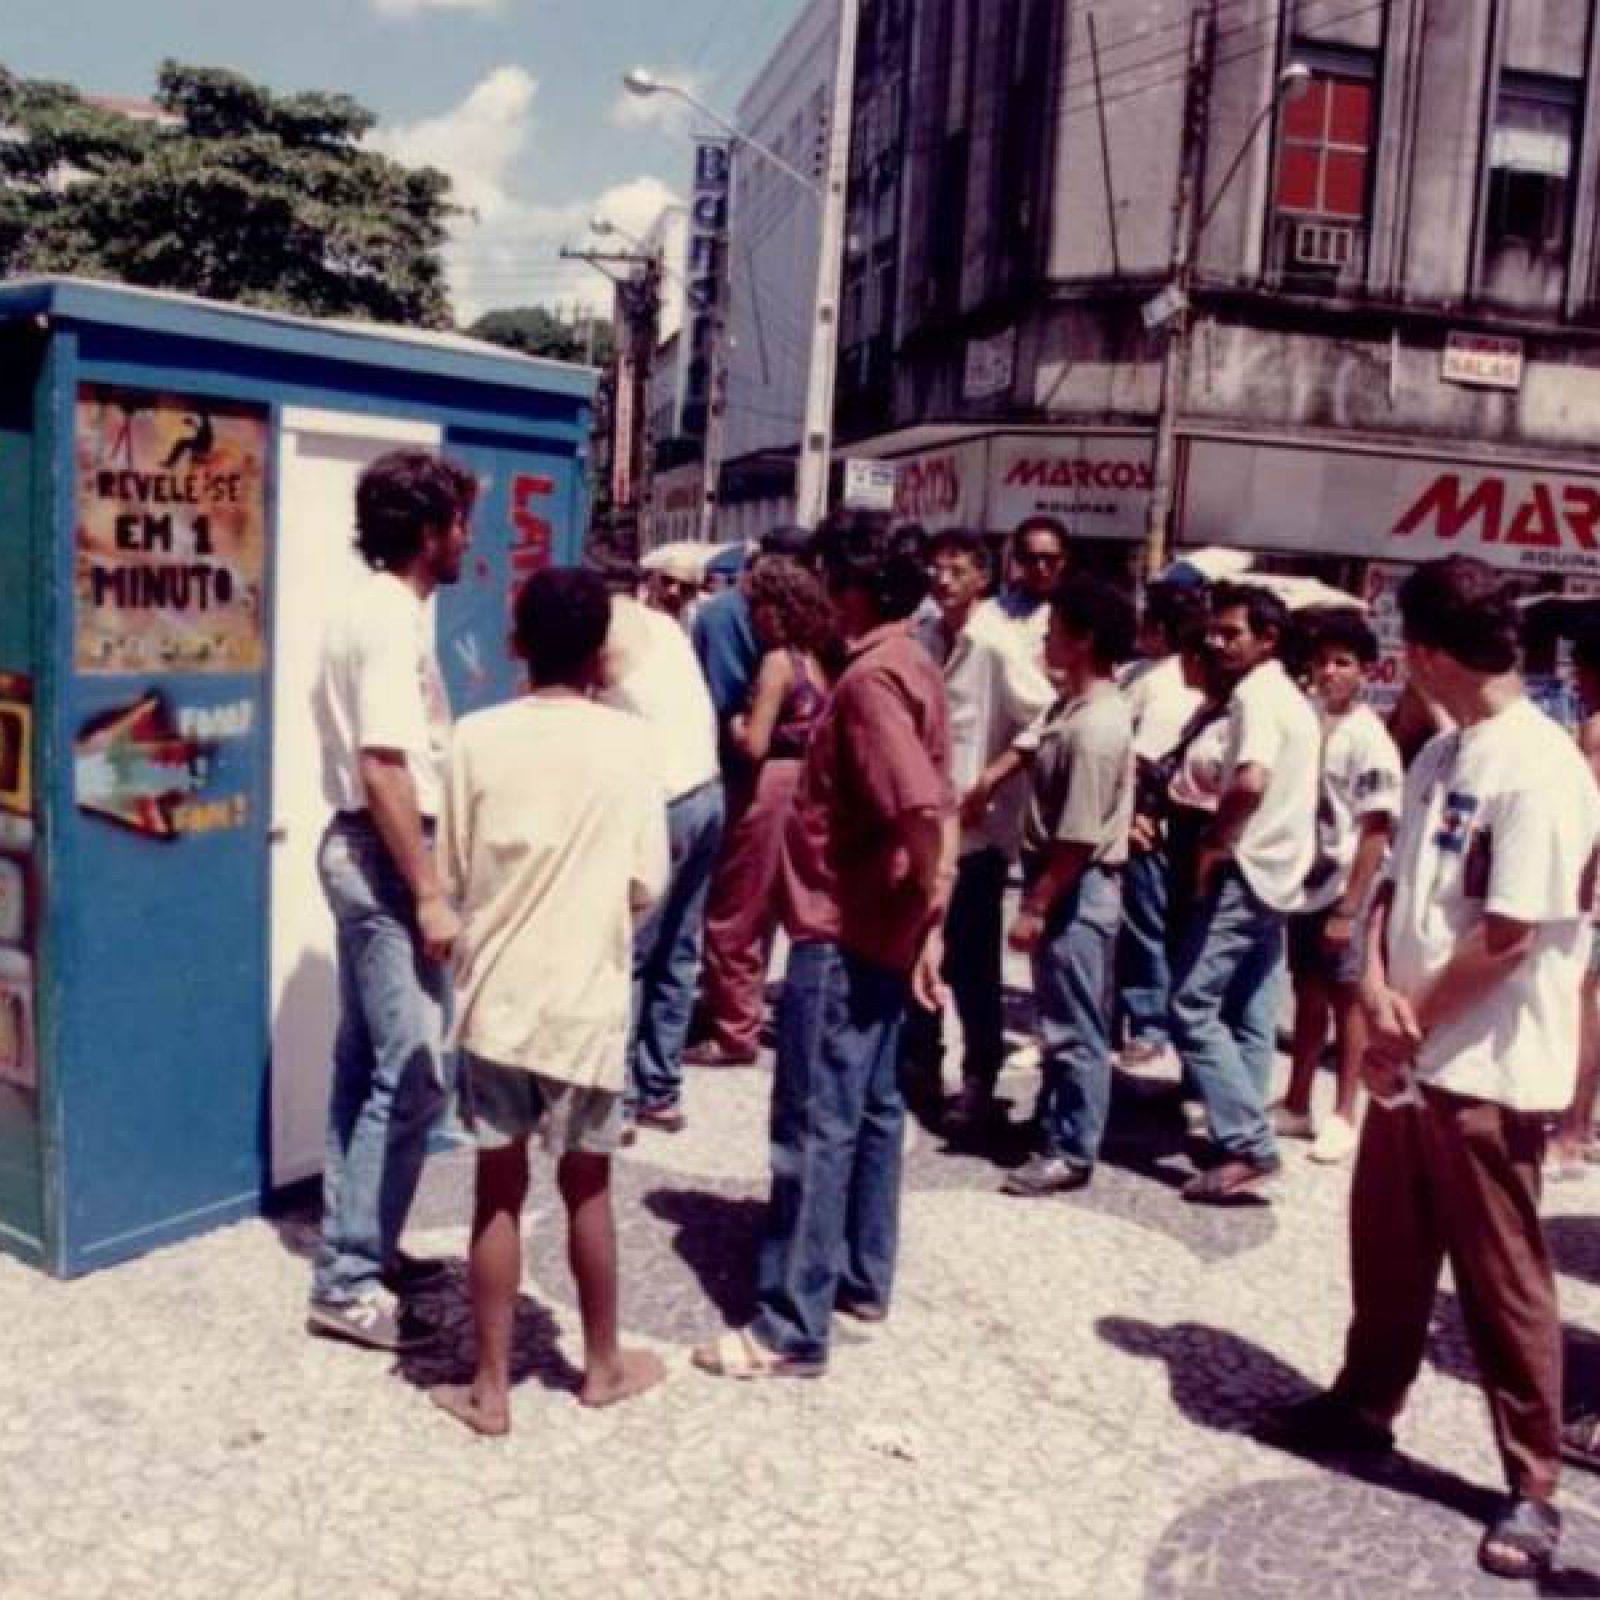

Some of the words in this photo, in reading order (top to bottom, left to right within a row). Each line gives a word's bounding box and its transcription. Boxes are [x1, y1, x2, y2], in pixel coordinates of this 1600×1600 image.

[1004, 458, 1155, 488] MARCOS
[115, 513, 172, 552] EM
[192, 513, 213, 555] 1
[1391, 474, 1600, 550] MAR
[91, 563, 233, 613] MINUTO
